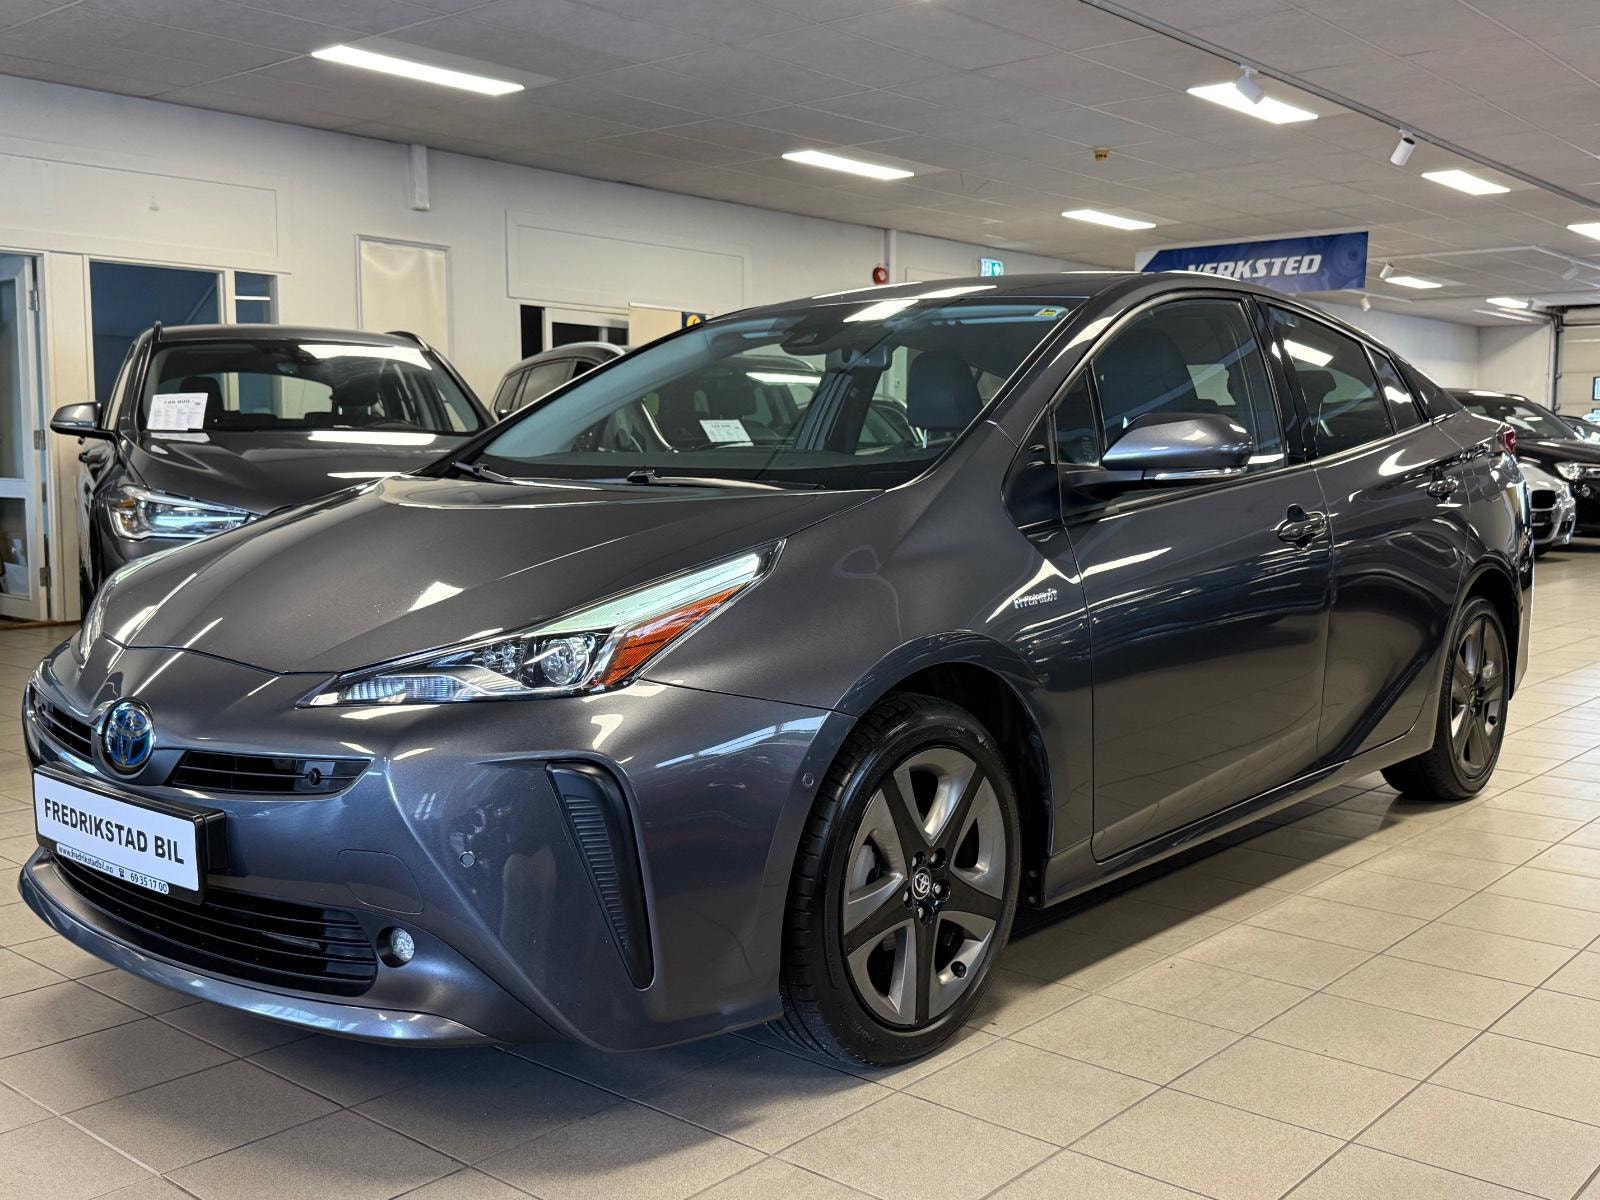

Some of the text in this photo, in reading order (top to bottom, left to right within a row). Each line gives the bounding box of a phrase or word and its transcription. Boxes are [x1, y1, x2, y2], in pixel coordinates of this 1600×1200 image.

[44, 798, 185, 865] FREDRIKSTAD BIL
[130, 872, 139, 883] 69
[140, 875, 148, 887] 35
[149, 878, 157, 889] 17
[158, 881, 168, 893] 00
